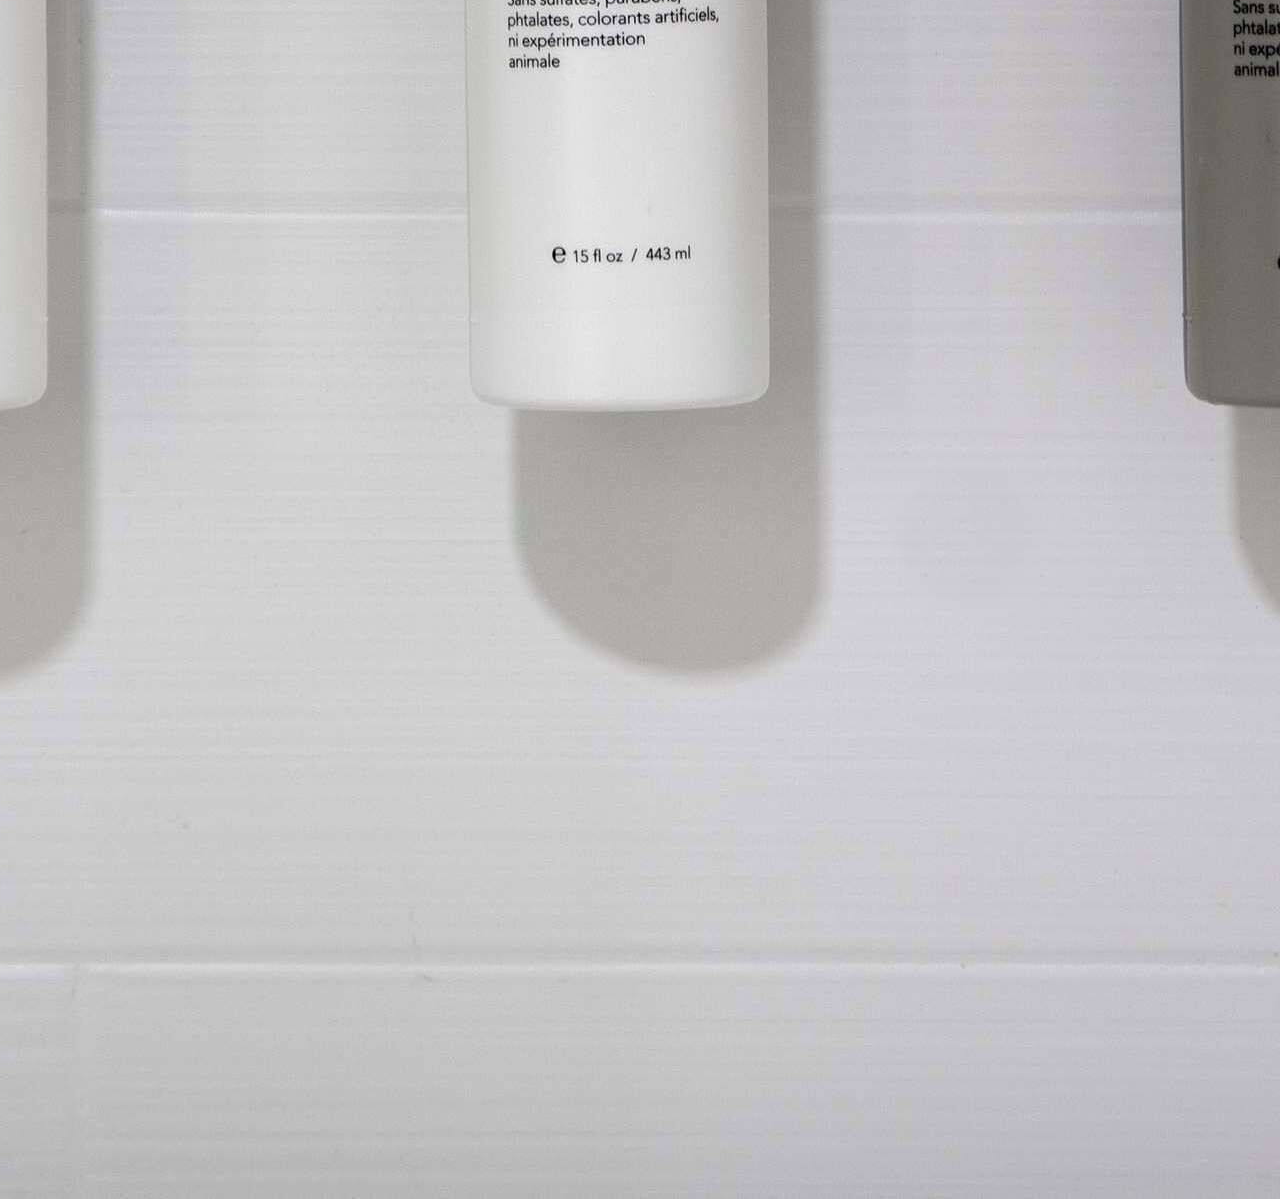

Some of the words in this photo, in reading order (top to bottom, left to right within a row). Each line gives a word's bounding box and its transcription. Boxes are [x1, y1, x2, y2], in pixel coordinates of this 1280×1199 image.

[1233, 0, 1265, 14] Sans
[508, 13, 573, 30] phtalates,
[578, 11, 650, 26] colorants
[655, 6, 720, 23] artificiels,
[508, 36, 518, 47] ni
[522, 32, 646, 51] expérimentation
[1234, 43, 1245, 56] ni
[509, 54, 561, 68] animale
[573, 250, 589, 263] 15
[593, 249, 601, 262] fl
[606, 252, 623, 263] oz
[646, 247, 671, 260] 443
[675, 245, 691, 259] ml
